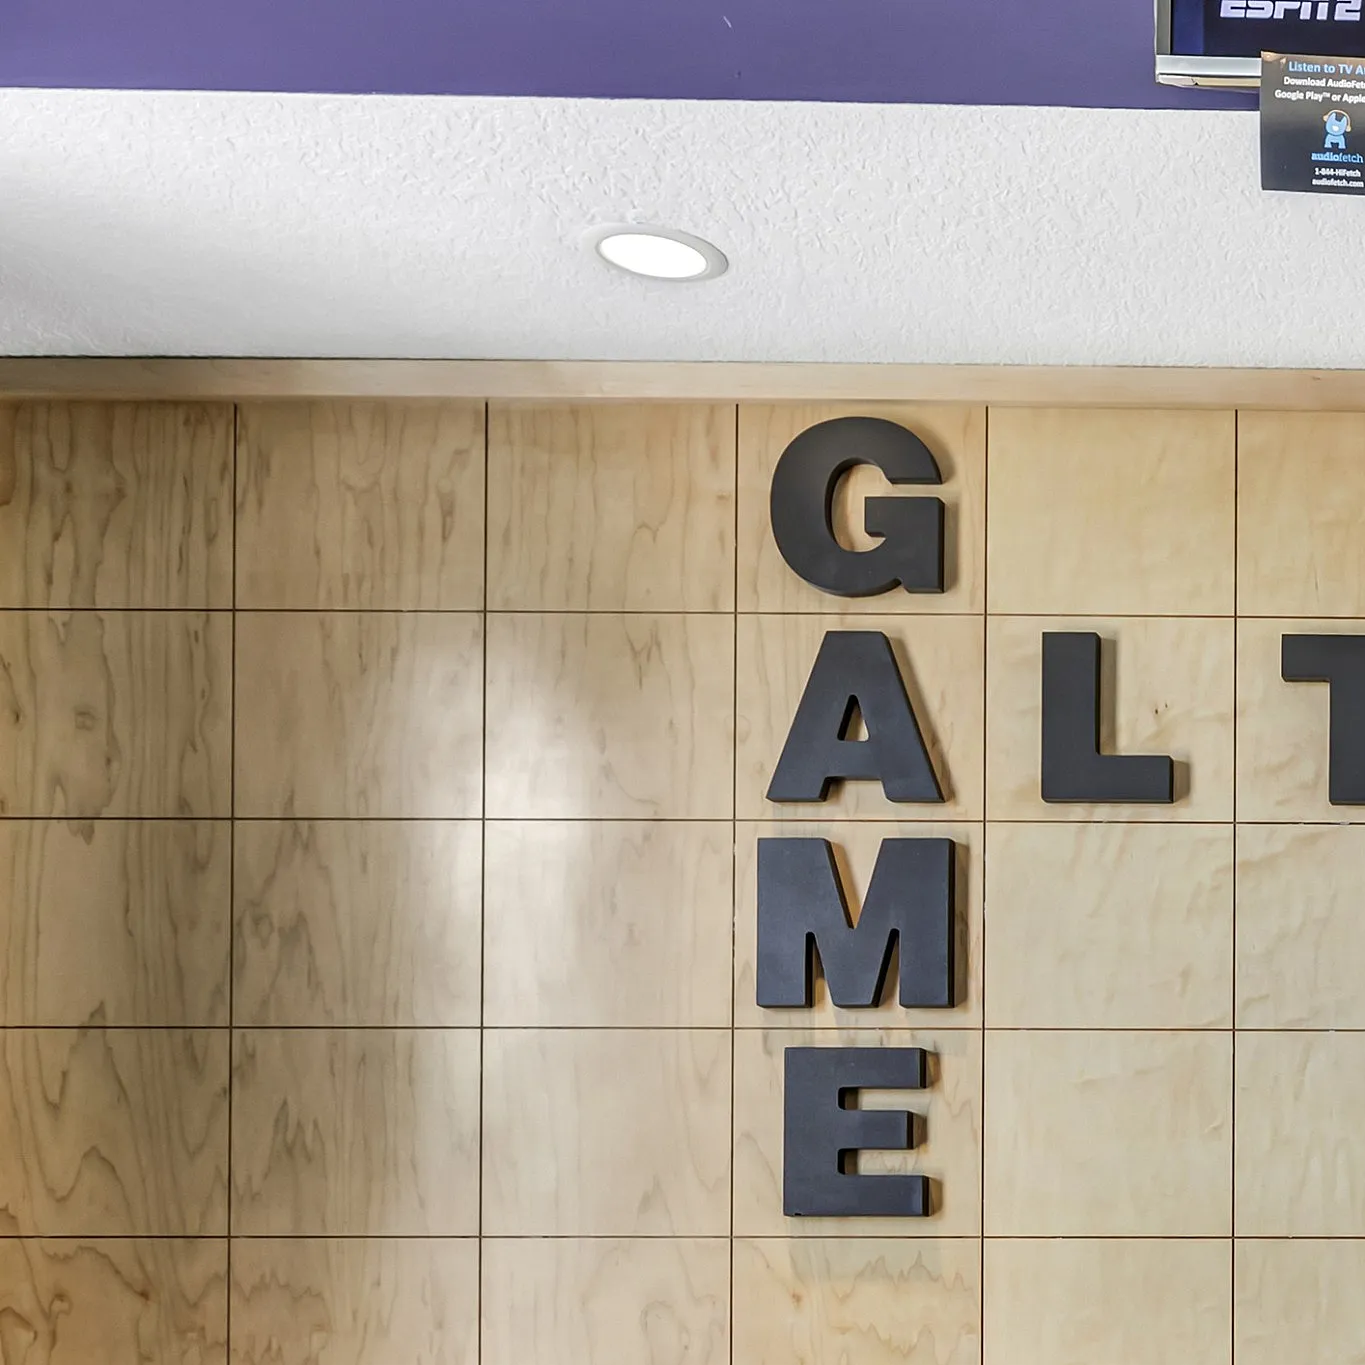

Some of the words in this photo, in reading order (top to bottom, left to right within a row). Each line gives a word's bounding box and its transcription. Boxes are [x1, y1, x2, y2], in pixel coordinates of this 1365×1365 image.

[1219, 0, 1361, 21] ESPN2
[1288, 61, 1320, 73] Listen
[1323, 64, 1336, 74] to
[1338, 64, 1353, 75] TV
[1283, 76, 1326, 87] Download
[1274, 89, 1304, 100] Google
[1331, 94, 1341, 102] or
[1311, 152, 1364, 163] audiofetch
[757, 416, 956, 1217] GAME
